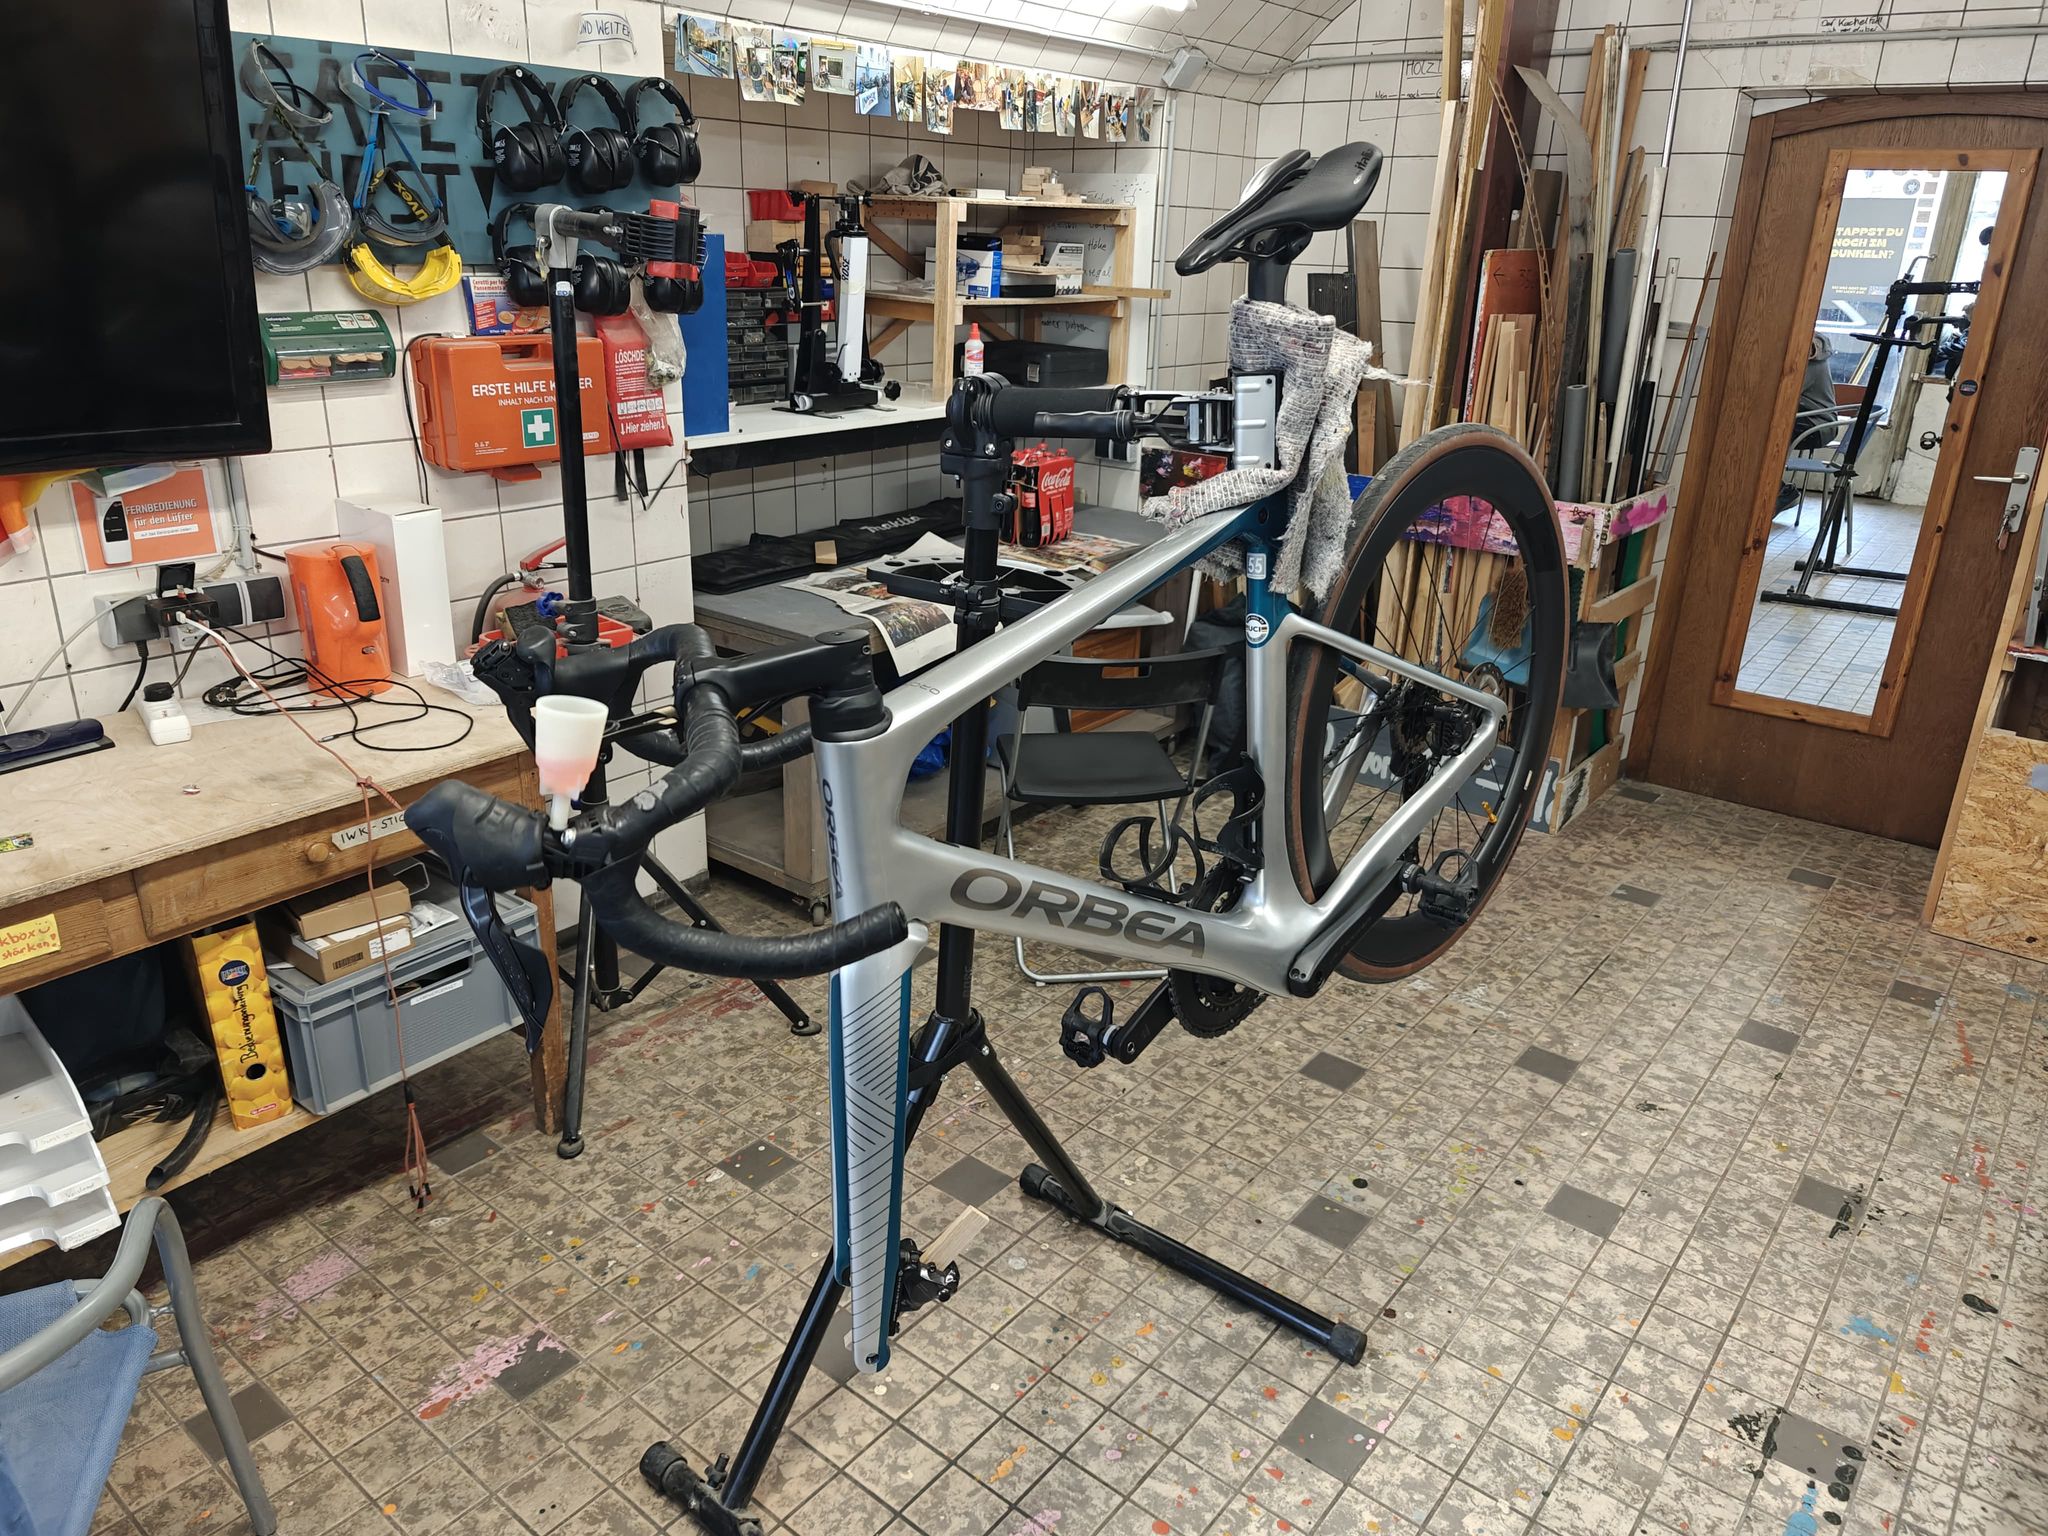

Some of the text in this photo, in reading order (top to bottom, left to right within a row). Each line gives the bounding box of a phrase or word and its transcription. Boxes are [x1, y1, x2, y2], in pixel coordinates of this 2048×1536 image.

[393, 181, 430, 222] uvex
[1836, 227, 1904, 237] TAPPST DU
[1833, 238, 1888, 248] NOCH IM
[1831, 249, 1895, 259] DUNKELN?
[615, 348, 646, 364] LÖSCHDE
[472, 377, 593, 397] ERSTE HILFE KER
[498, 395, 556, 406] INHALT NACH DIN
[625, 418, 661, 434] Hier ziehen
[126, 499, 197, 514] FERNBEDIENUNG
[134, 511, 194, 528] für den Lüfter
[1248, 557, 1263, 574] 55
[1248, 625, 1261, 633] UCI
[822, 778, 843, 900] ORBEA
[950, 868, 1206, 959] ORBEA
[0, 929, 36, 947] kbox
